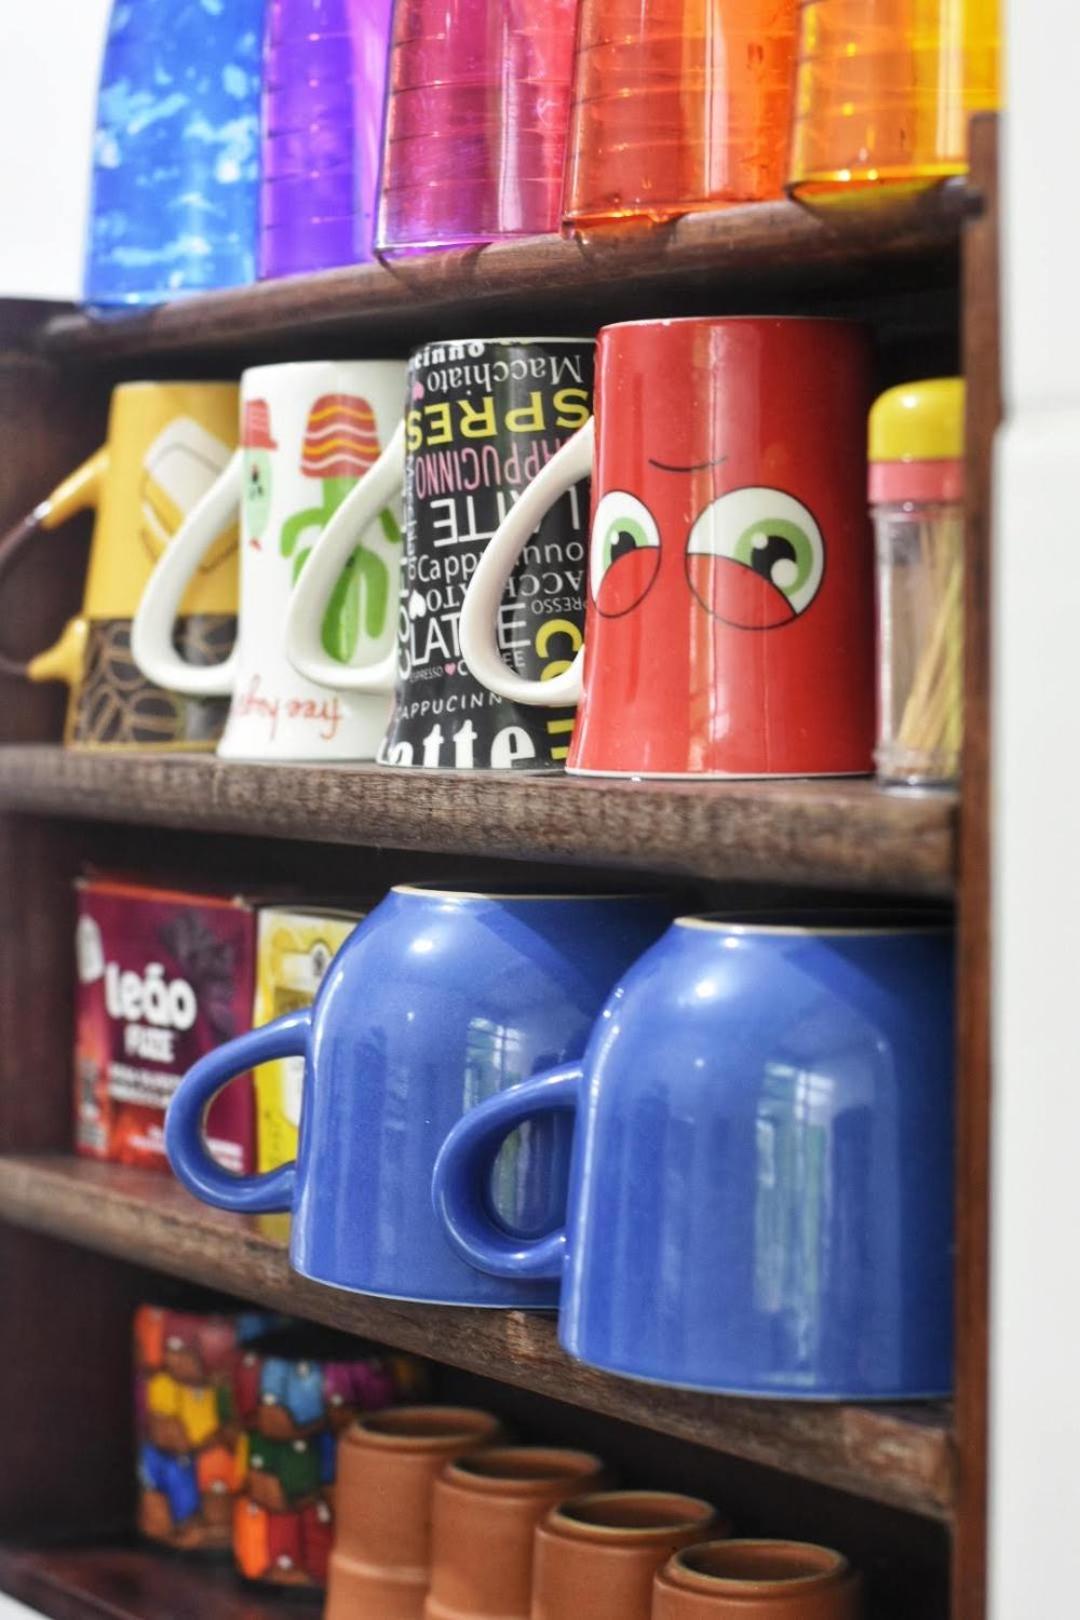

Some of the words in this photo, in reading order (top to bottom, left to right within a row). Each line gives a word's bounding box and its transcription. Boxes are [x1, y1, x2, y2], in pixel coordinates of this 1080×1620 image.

[426, 354, 585, 396] Macchiato
[406, 388, 591, 451] SPRES
[415, 437, 572, 499] PPUCINNO
[430, 484, 581, 548] LTTE
[417, 541, 584, 583] Cappnno
[426, 569, 585, 612] ACCHTO
[530, 596, 587, 615] RESSO
[410, 602, 531, 668] LATE
[398, 691, 502, 720] APPUCINN
